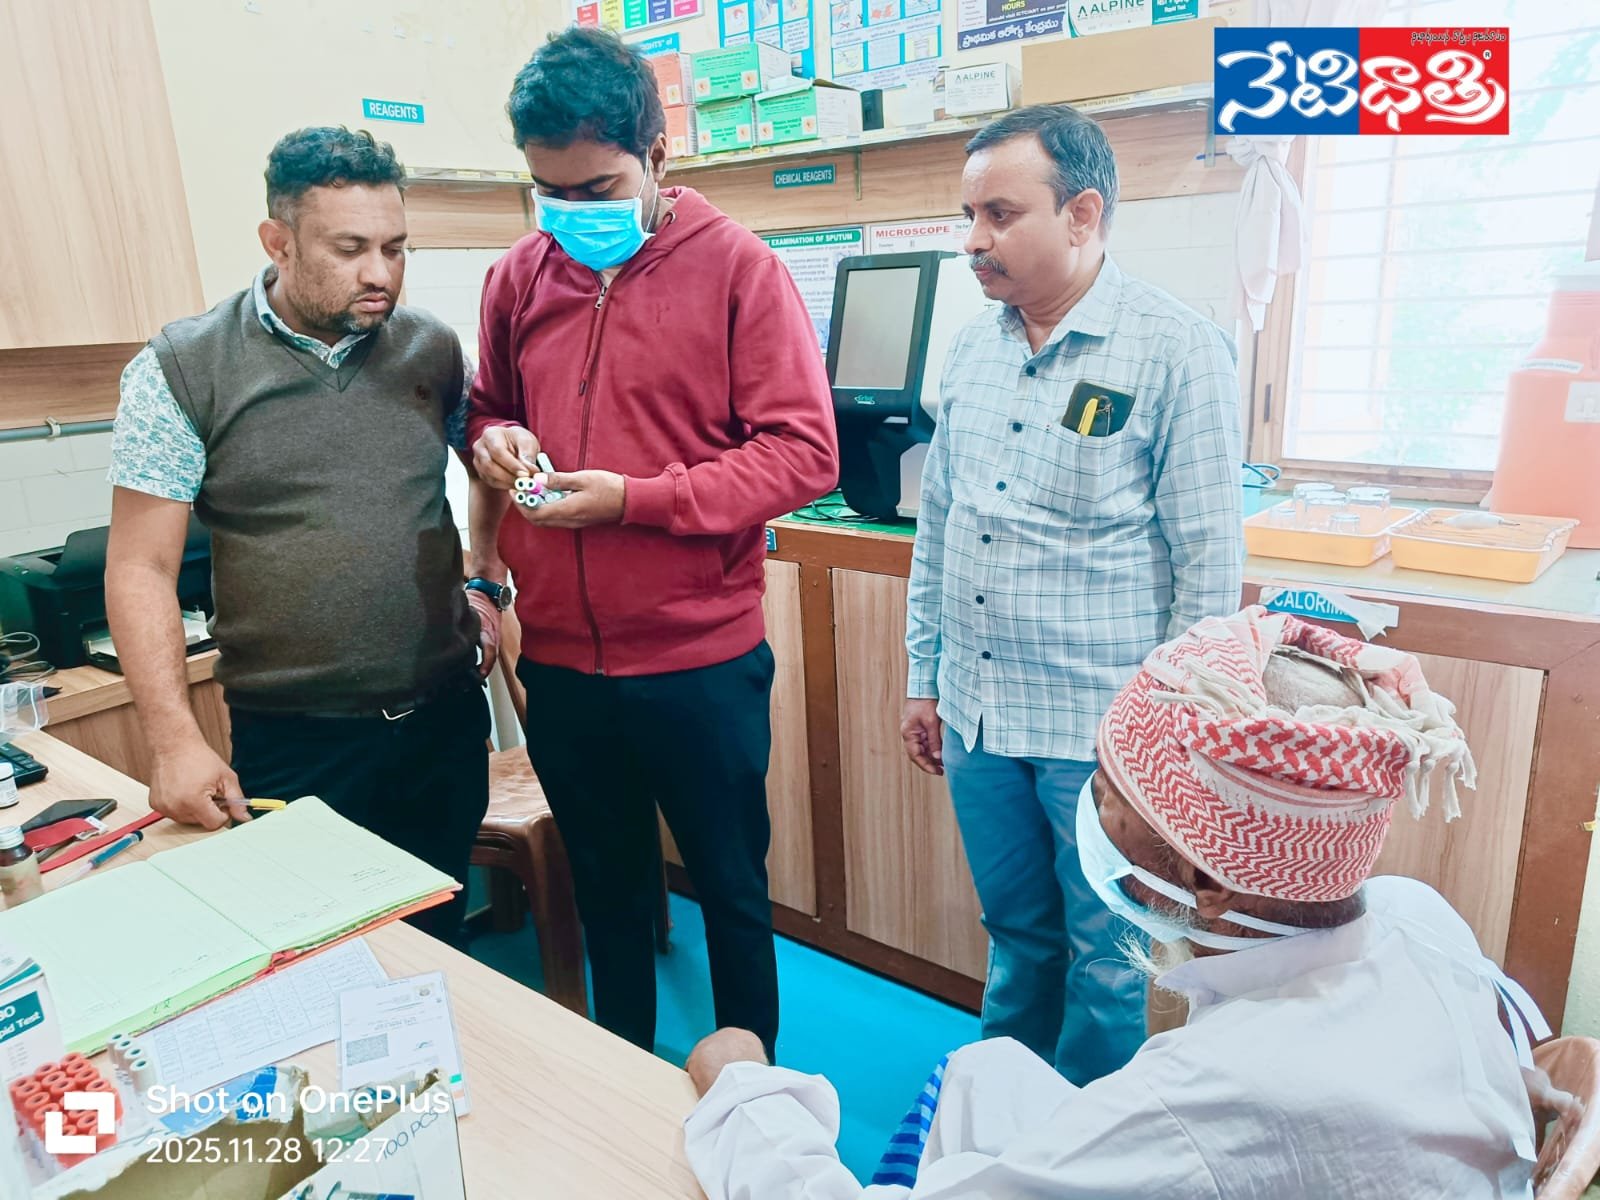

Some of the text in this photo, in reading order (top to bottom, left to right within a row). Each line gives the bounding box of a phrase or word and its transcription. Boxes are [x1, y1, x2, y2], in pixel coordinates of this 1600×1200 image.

[1001, 0, 1026, 12] HOURS
[1090, 0, 1145, 14] ALPINE
[962, 70, 996, 81] ALPINE
[369, 102, 418, 120] REAGENTS
[775, 169, 833, 185] CHEMICAL REAGENTS
[875, 225, 951, 238] MICROSCOPE
[771, 236, 814, 246] EXAMINATION
[815, 235, 825, 243] OF
[825, 232, 853, 242] SPUTUM
[16, 1011, 41, 1028] Test
[411, 1106, 441, 1136] PCS
